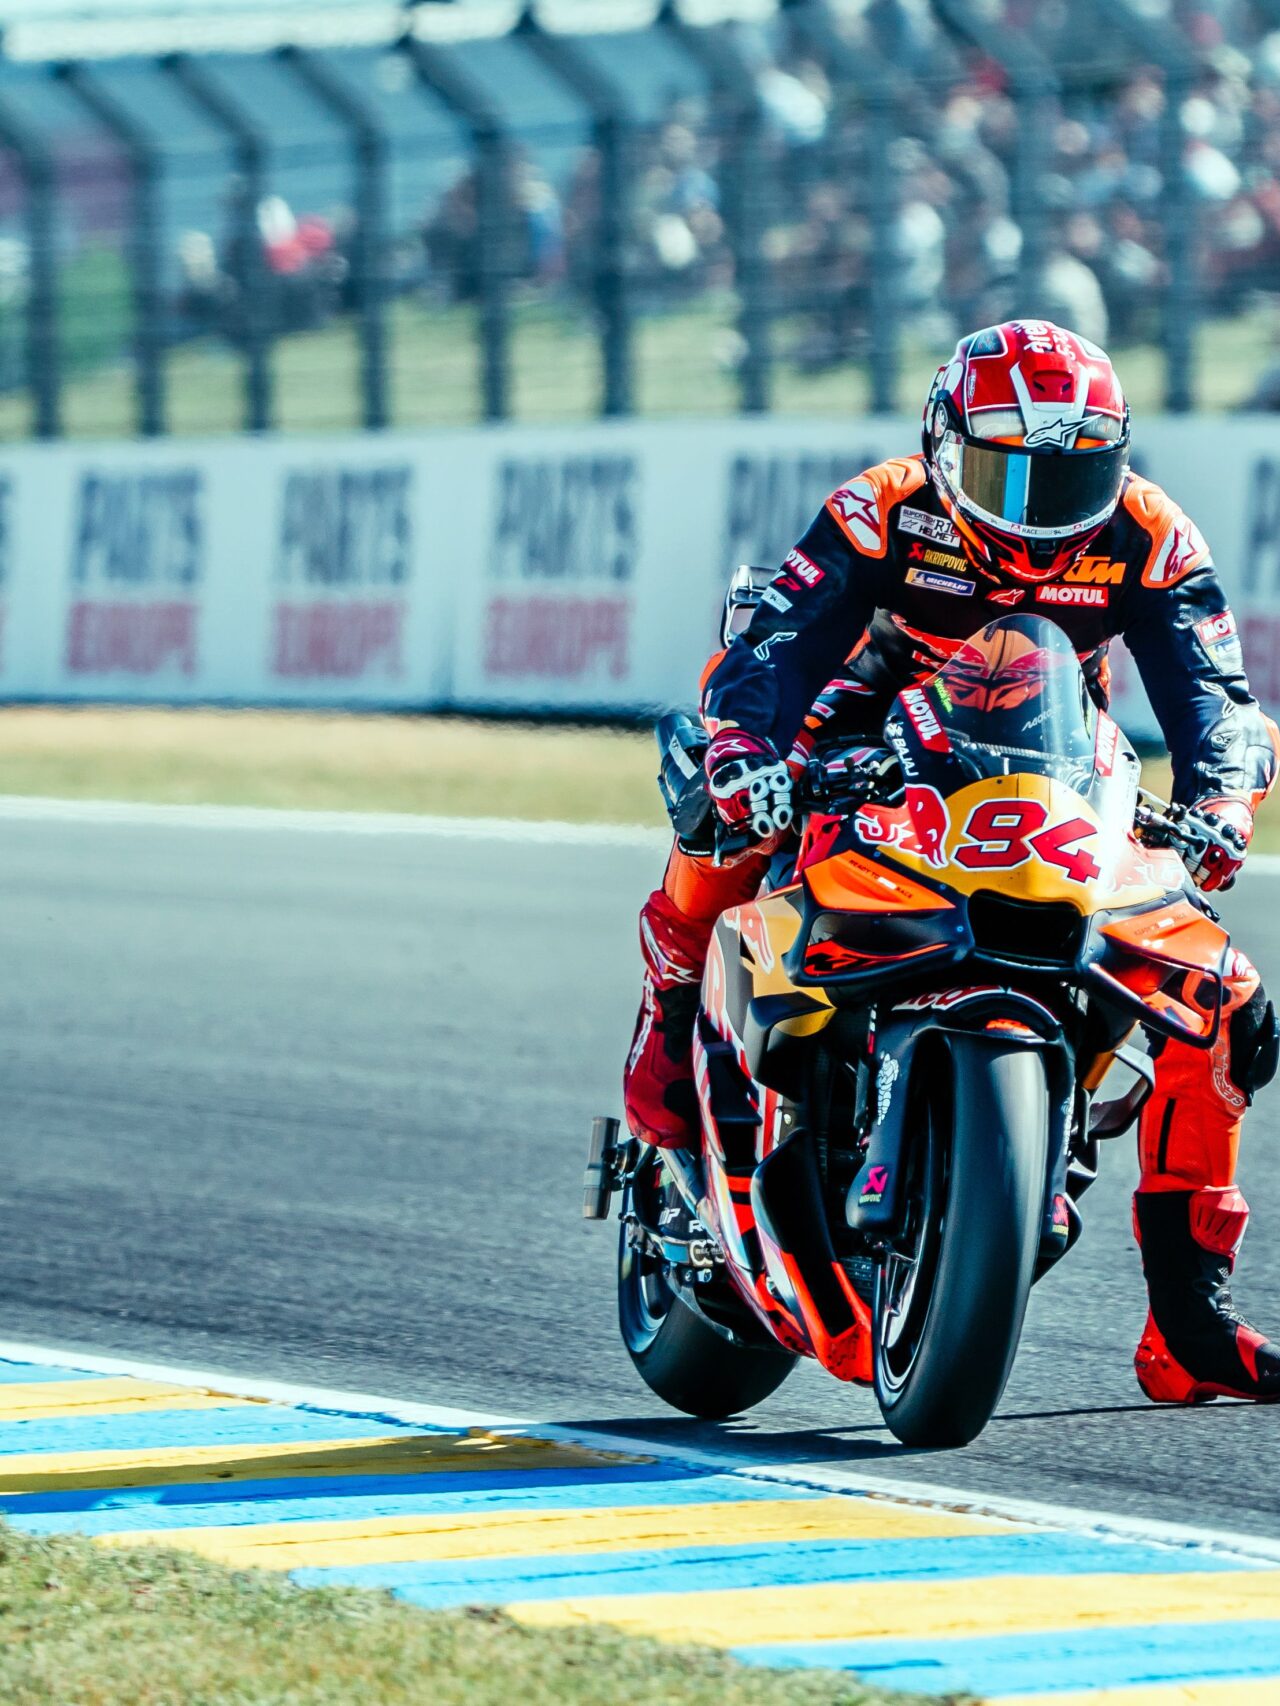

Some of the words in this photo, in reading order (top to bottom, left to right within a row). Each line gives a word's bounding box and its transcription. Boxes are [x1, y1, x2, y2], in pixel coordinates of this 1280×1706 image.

[722, 448, 886, 582] PAR
[918, 525, 958, 544] HELMET
[785, 549, 820, 584] OTUL
[1062, 556, 1127, 584] KTM
[1039, 586, 1105, 604] MOTUL
[1202, 616, 1237, 641] MOT
[901, 687, 943, 742] MOTUL
[893, 738, 919, 777] BAJAJ
[951, 798, 1102, 884] 94
